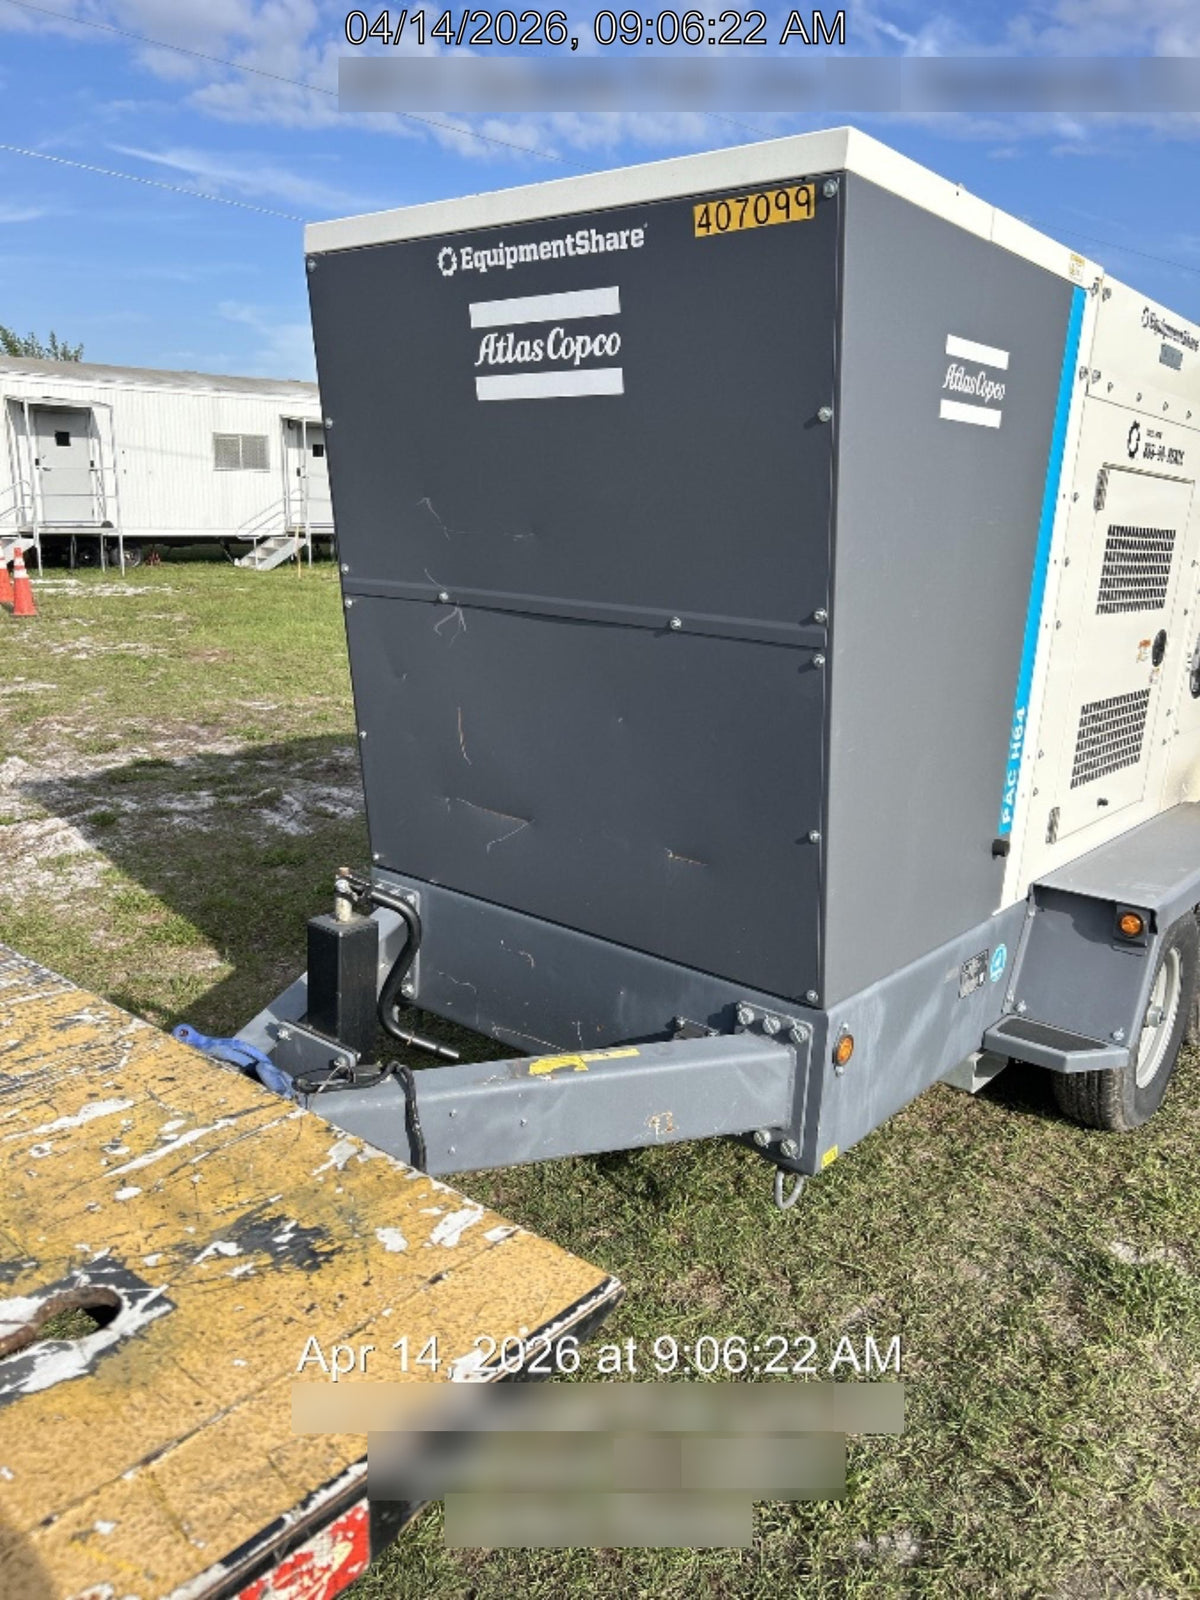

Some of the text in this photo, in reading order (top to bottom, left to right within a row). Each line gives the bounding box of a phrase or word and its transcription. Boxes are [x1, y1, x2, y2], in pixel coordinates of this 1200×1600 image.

[696, 186, 813, 234] 407099
[460, 228, 646, 273] EquipmentShare
[474, 326, 622, 367] Atlas Copco
[941, 363, 1006, 404] Atlas Copco
[1001, 768, 1018, 824] PAC
